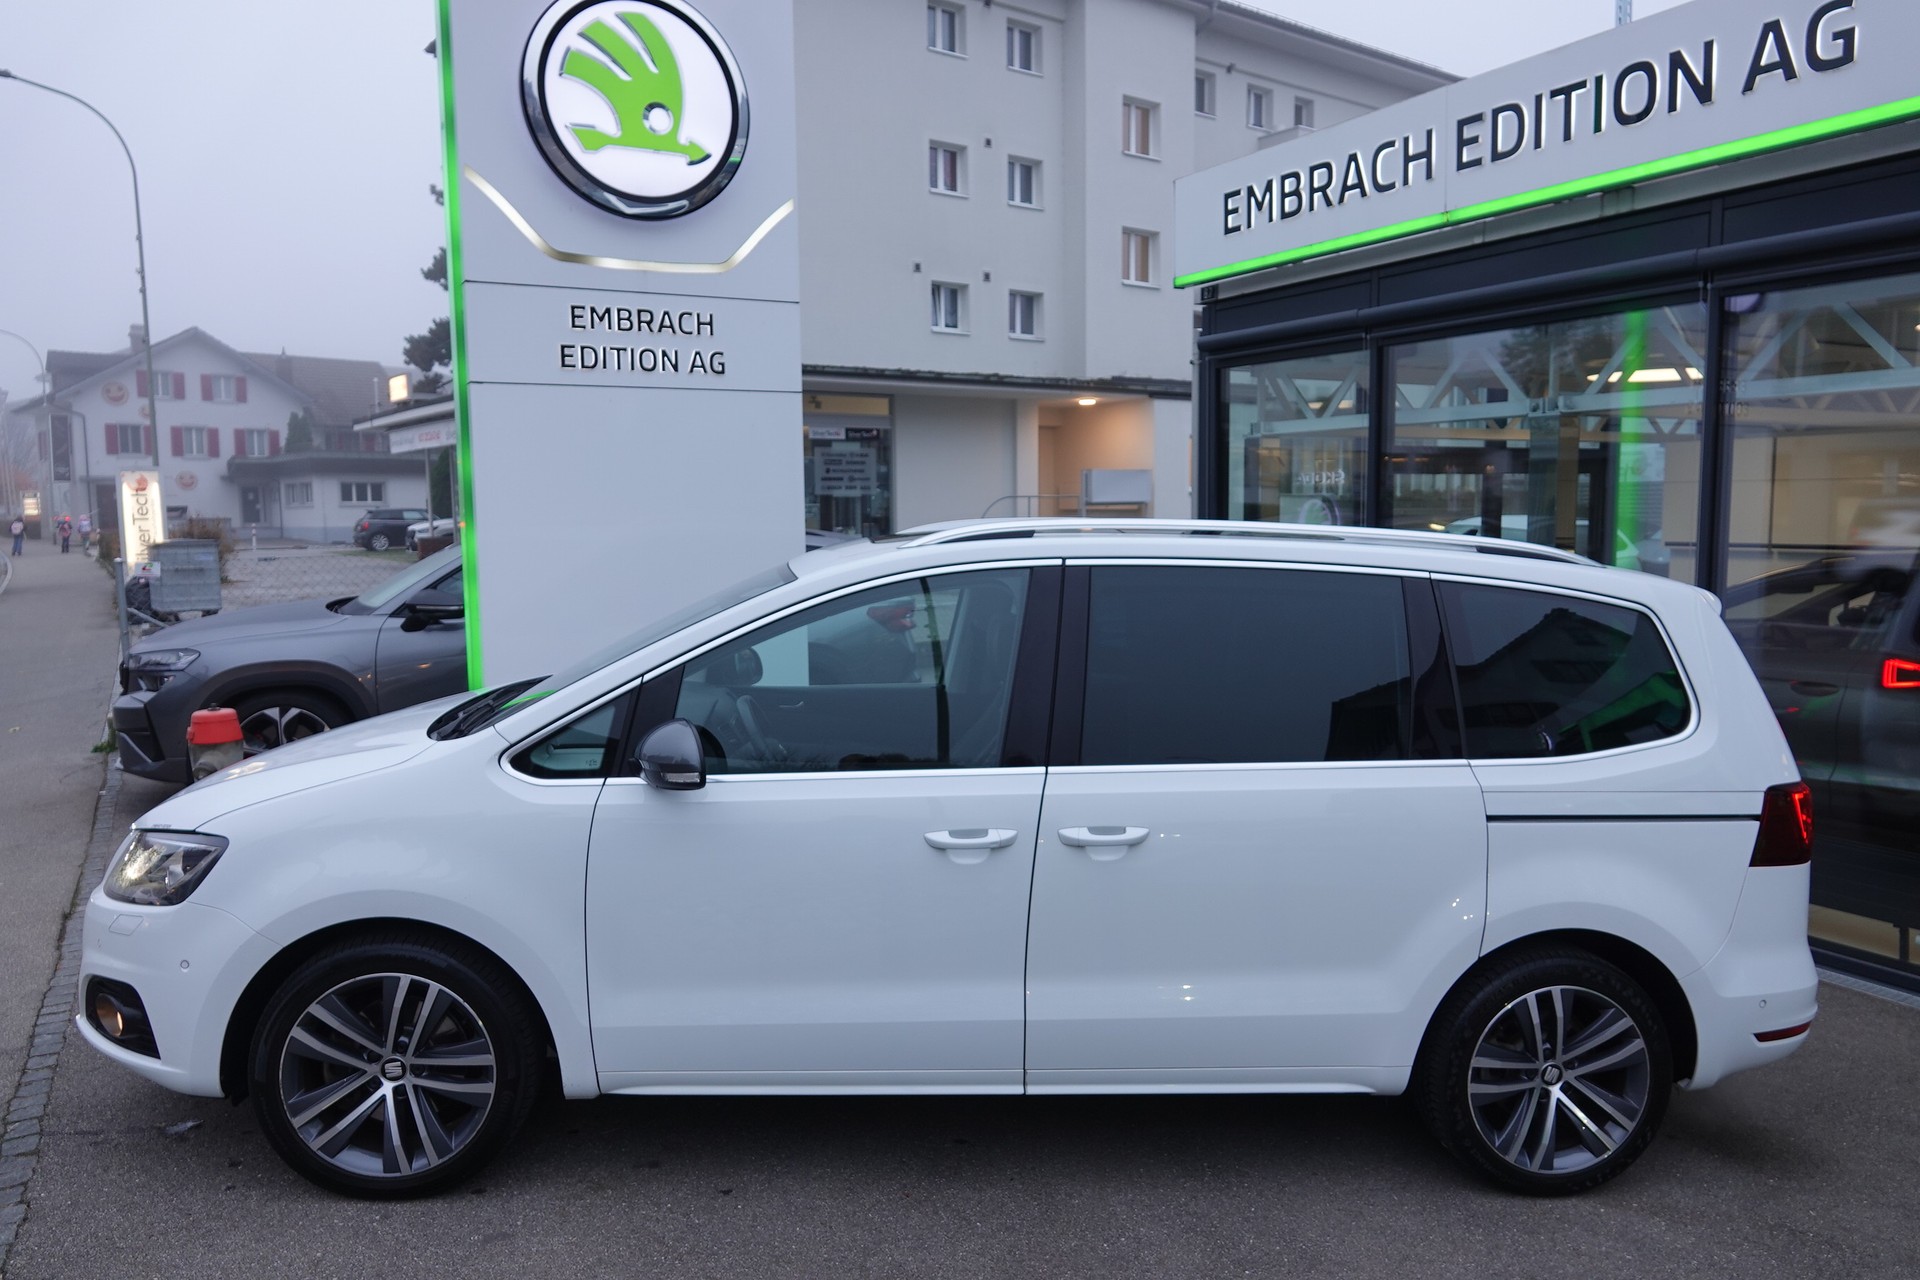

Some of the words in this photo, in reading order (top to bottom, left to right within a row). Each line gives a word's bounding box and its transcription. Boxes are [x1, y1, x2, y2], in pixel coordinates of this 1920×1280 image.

[1224, 127, 1436, 236] EMBRACH
[1456, 38, 1718, 172] EDITION
[1741, 0, 1859, 95] AG
[570, 304, 714, 336] EMBRACH
[559, 344, 679, 373] EDITION
[688, 350, 726, 375] AG
[134, 525, 151, 562] ilver
